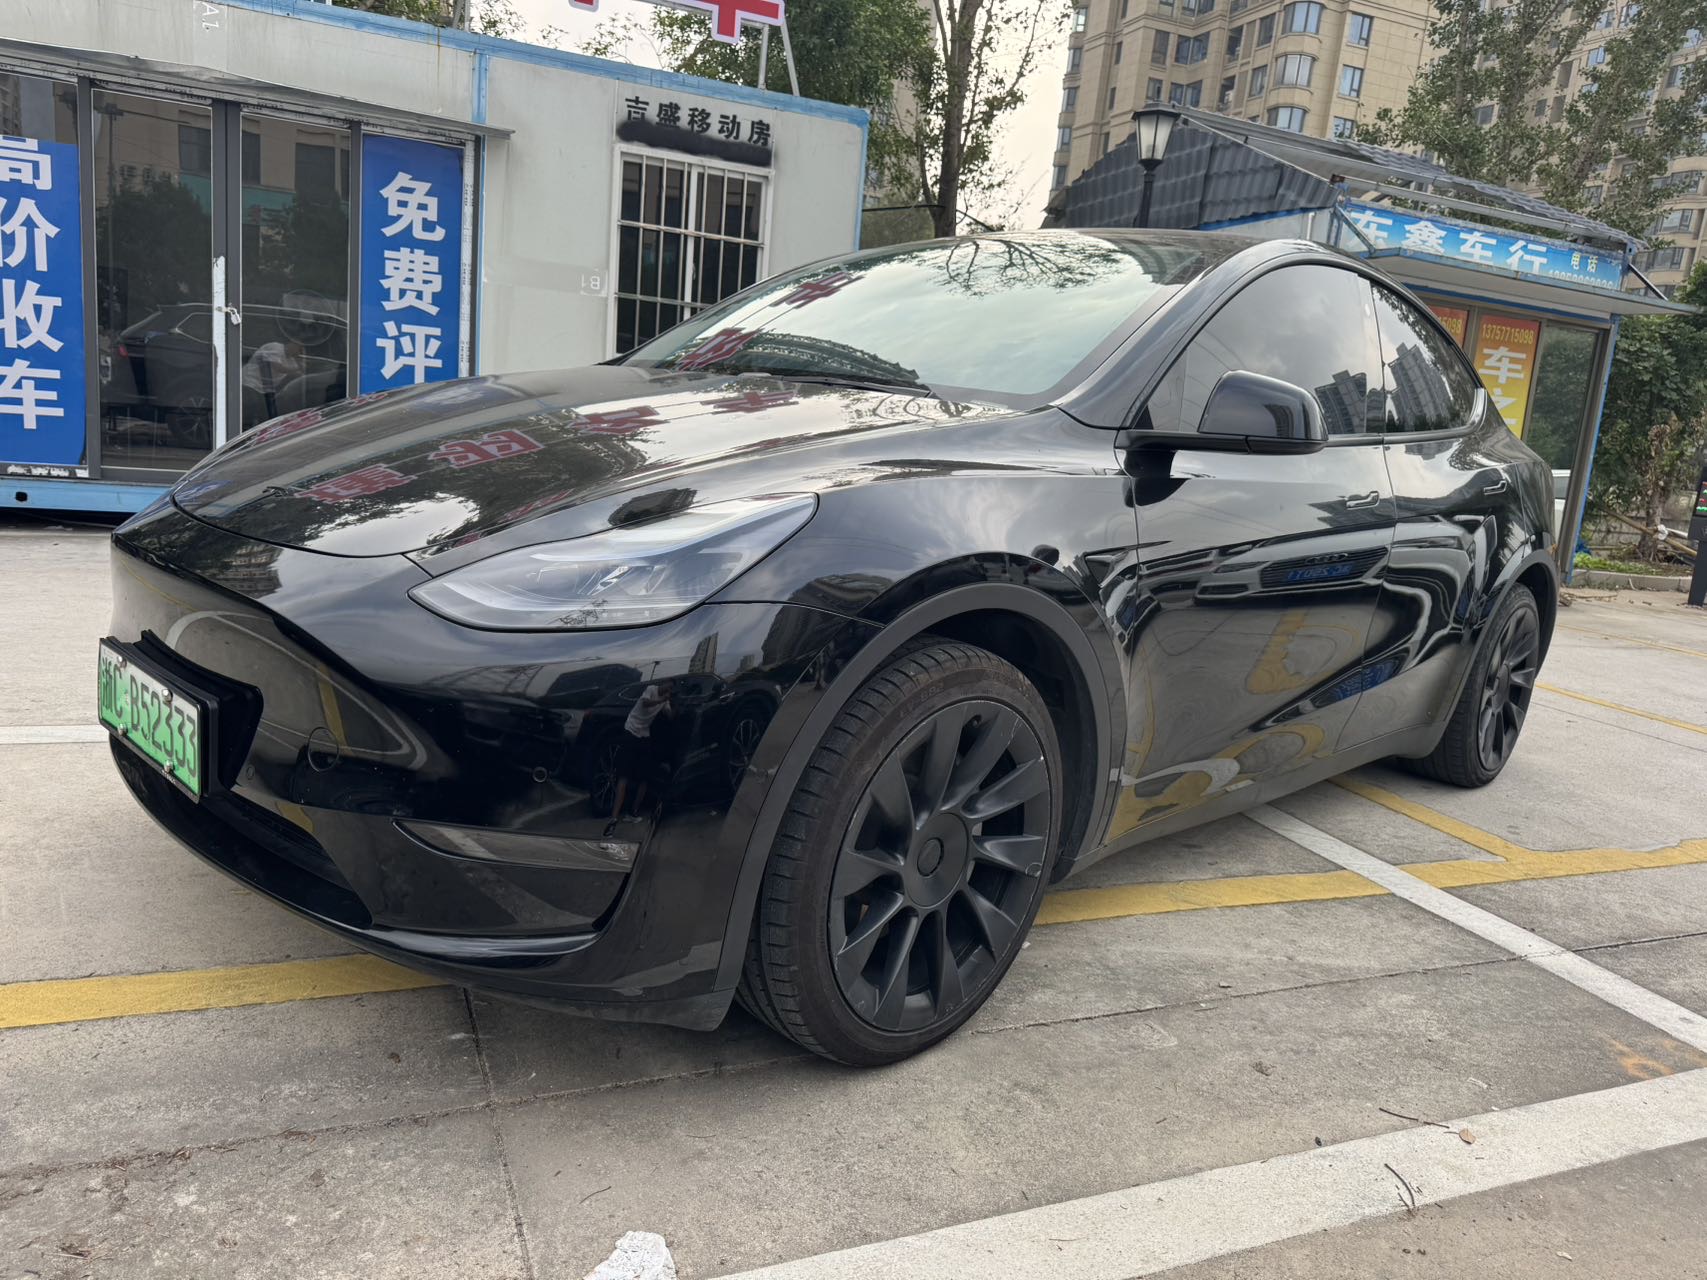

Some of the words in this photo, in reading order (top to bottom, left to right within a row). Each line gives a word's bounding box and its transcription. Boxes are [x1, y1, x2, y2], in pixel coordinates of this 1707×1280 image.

[625, 96, 771, 146] 吉盛移动房
[1571, 251, 1599, 273] 电话
[1482, 323, 1534, 345] 13757715098
